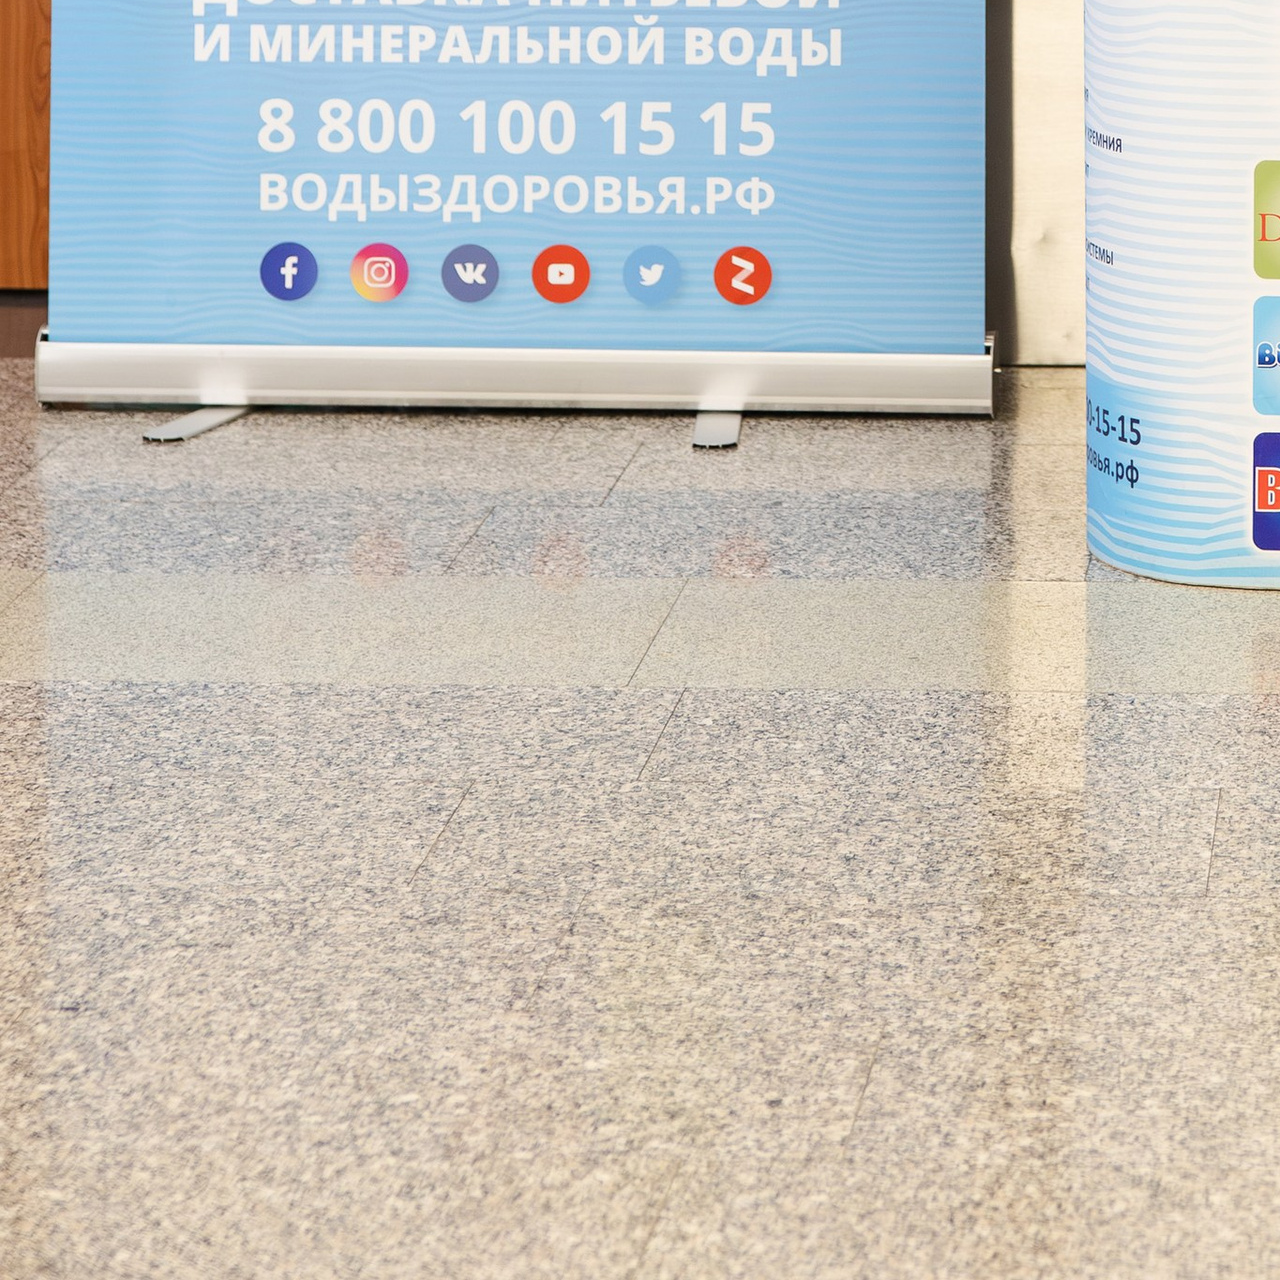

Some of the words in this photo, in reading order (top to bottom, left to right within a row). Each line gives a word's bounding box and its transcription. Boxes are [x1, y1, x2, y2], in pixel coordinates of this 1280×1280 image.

[194, 24, 229, 62] И
[250, 14, 664, 65] МИНЕРАЛЬНОЙ
[684, 26, 841, 77] ВОДЫ
[258, 97, 295, 153] 8
[318, 97, 436, 153] 800
[459, 98, 576, 154] 100
[600, 101, 674, 155] 15
[699, 101, 775, 156] 15
[259, 172, 775, 222] ВОДЫЗДОРОВЬЯ.РФ
